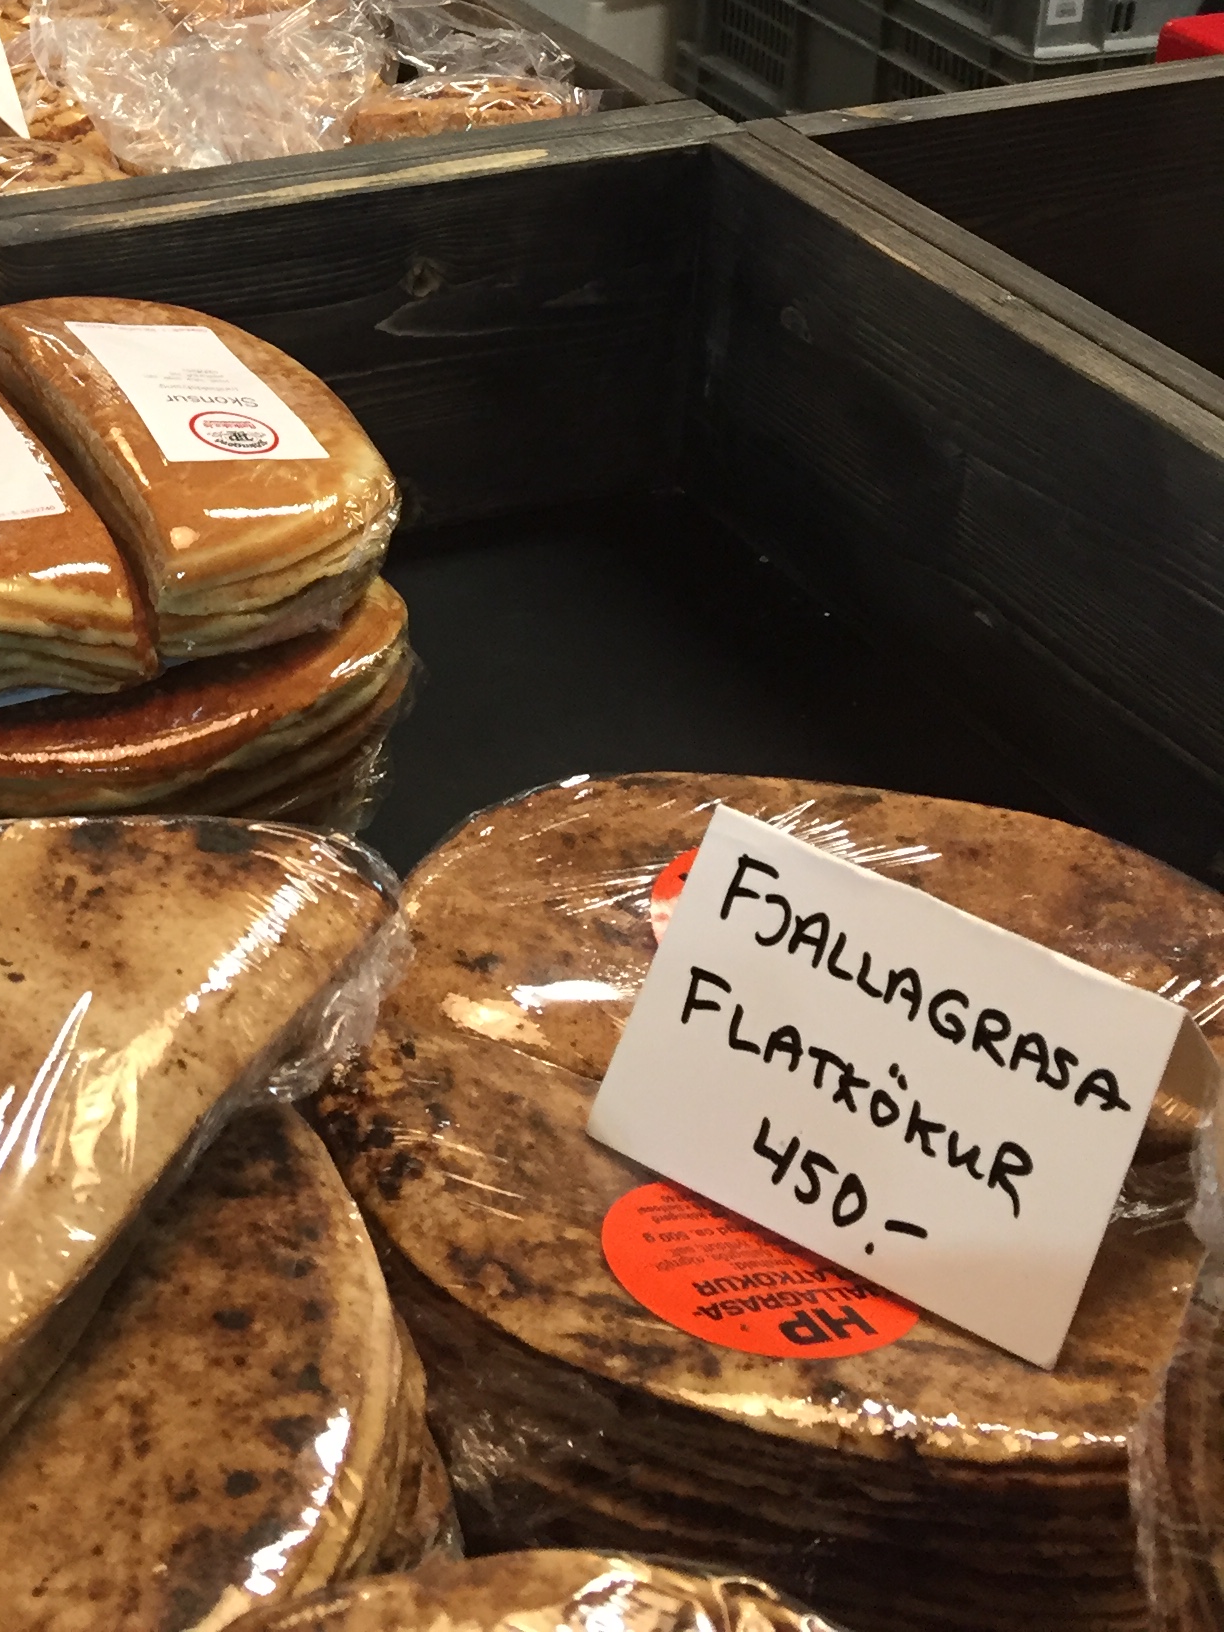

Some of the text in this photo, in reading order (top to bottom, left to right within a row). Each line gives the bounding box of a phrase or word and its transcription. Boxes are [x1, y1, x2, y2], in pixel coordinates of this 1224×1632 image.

[166, 394, 258, 408] Skonsur
[721, 854, 1131, 1111] FJALLAGRASA
[682, 966, 1034, 1218] FLATKÖKUR
[753, 1117, 928, 1256] 450.-
[778, 1304, 879, 1346] HP
